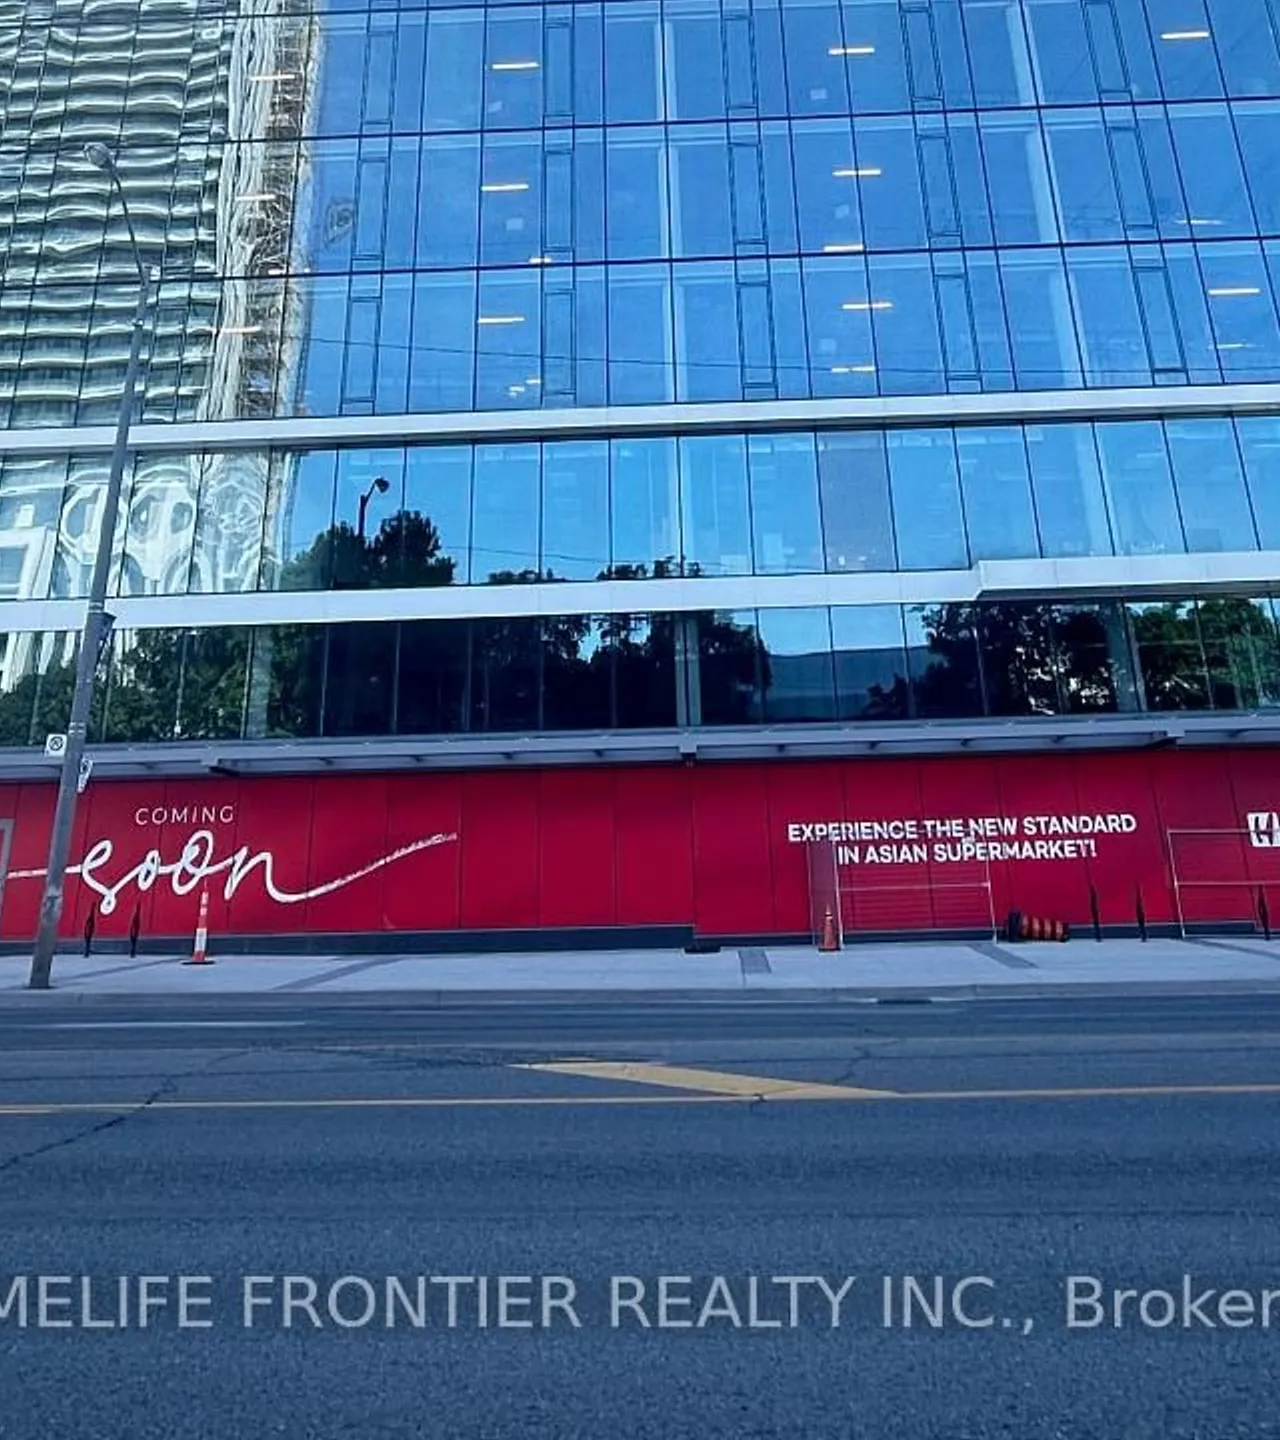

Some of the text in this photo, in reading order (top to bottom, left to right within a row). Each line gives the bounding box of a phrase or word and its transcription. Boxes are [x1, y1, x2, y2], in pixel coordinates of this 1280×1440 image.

[135, 805, 234, 826] COMING
[787, 813, 1137, 842] EXPERIENCE THE NEW STANDARD
[838, 839, 1097, 865] IN ASIAN SUPERMARKET!
[80, 830, 325, 914] soon
